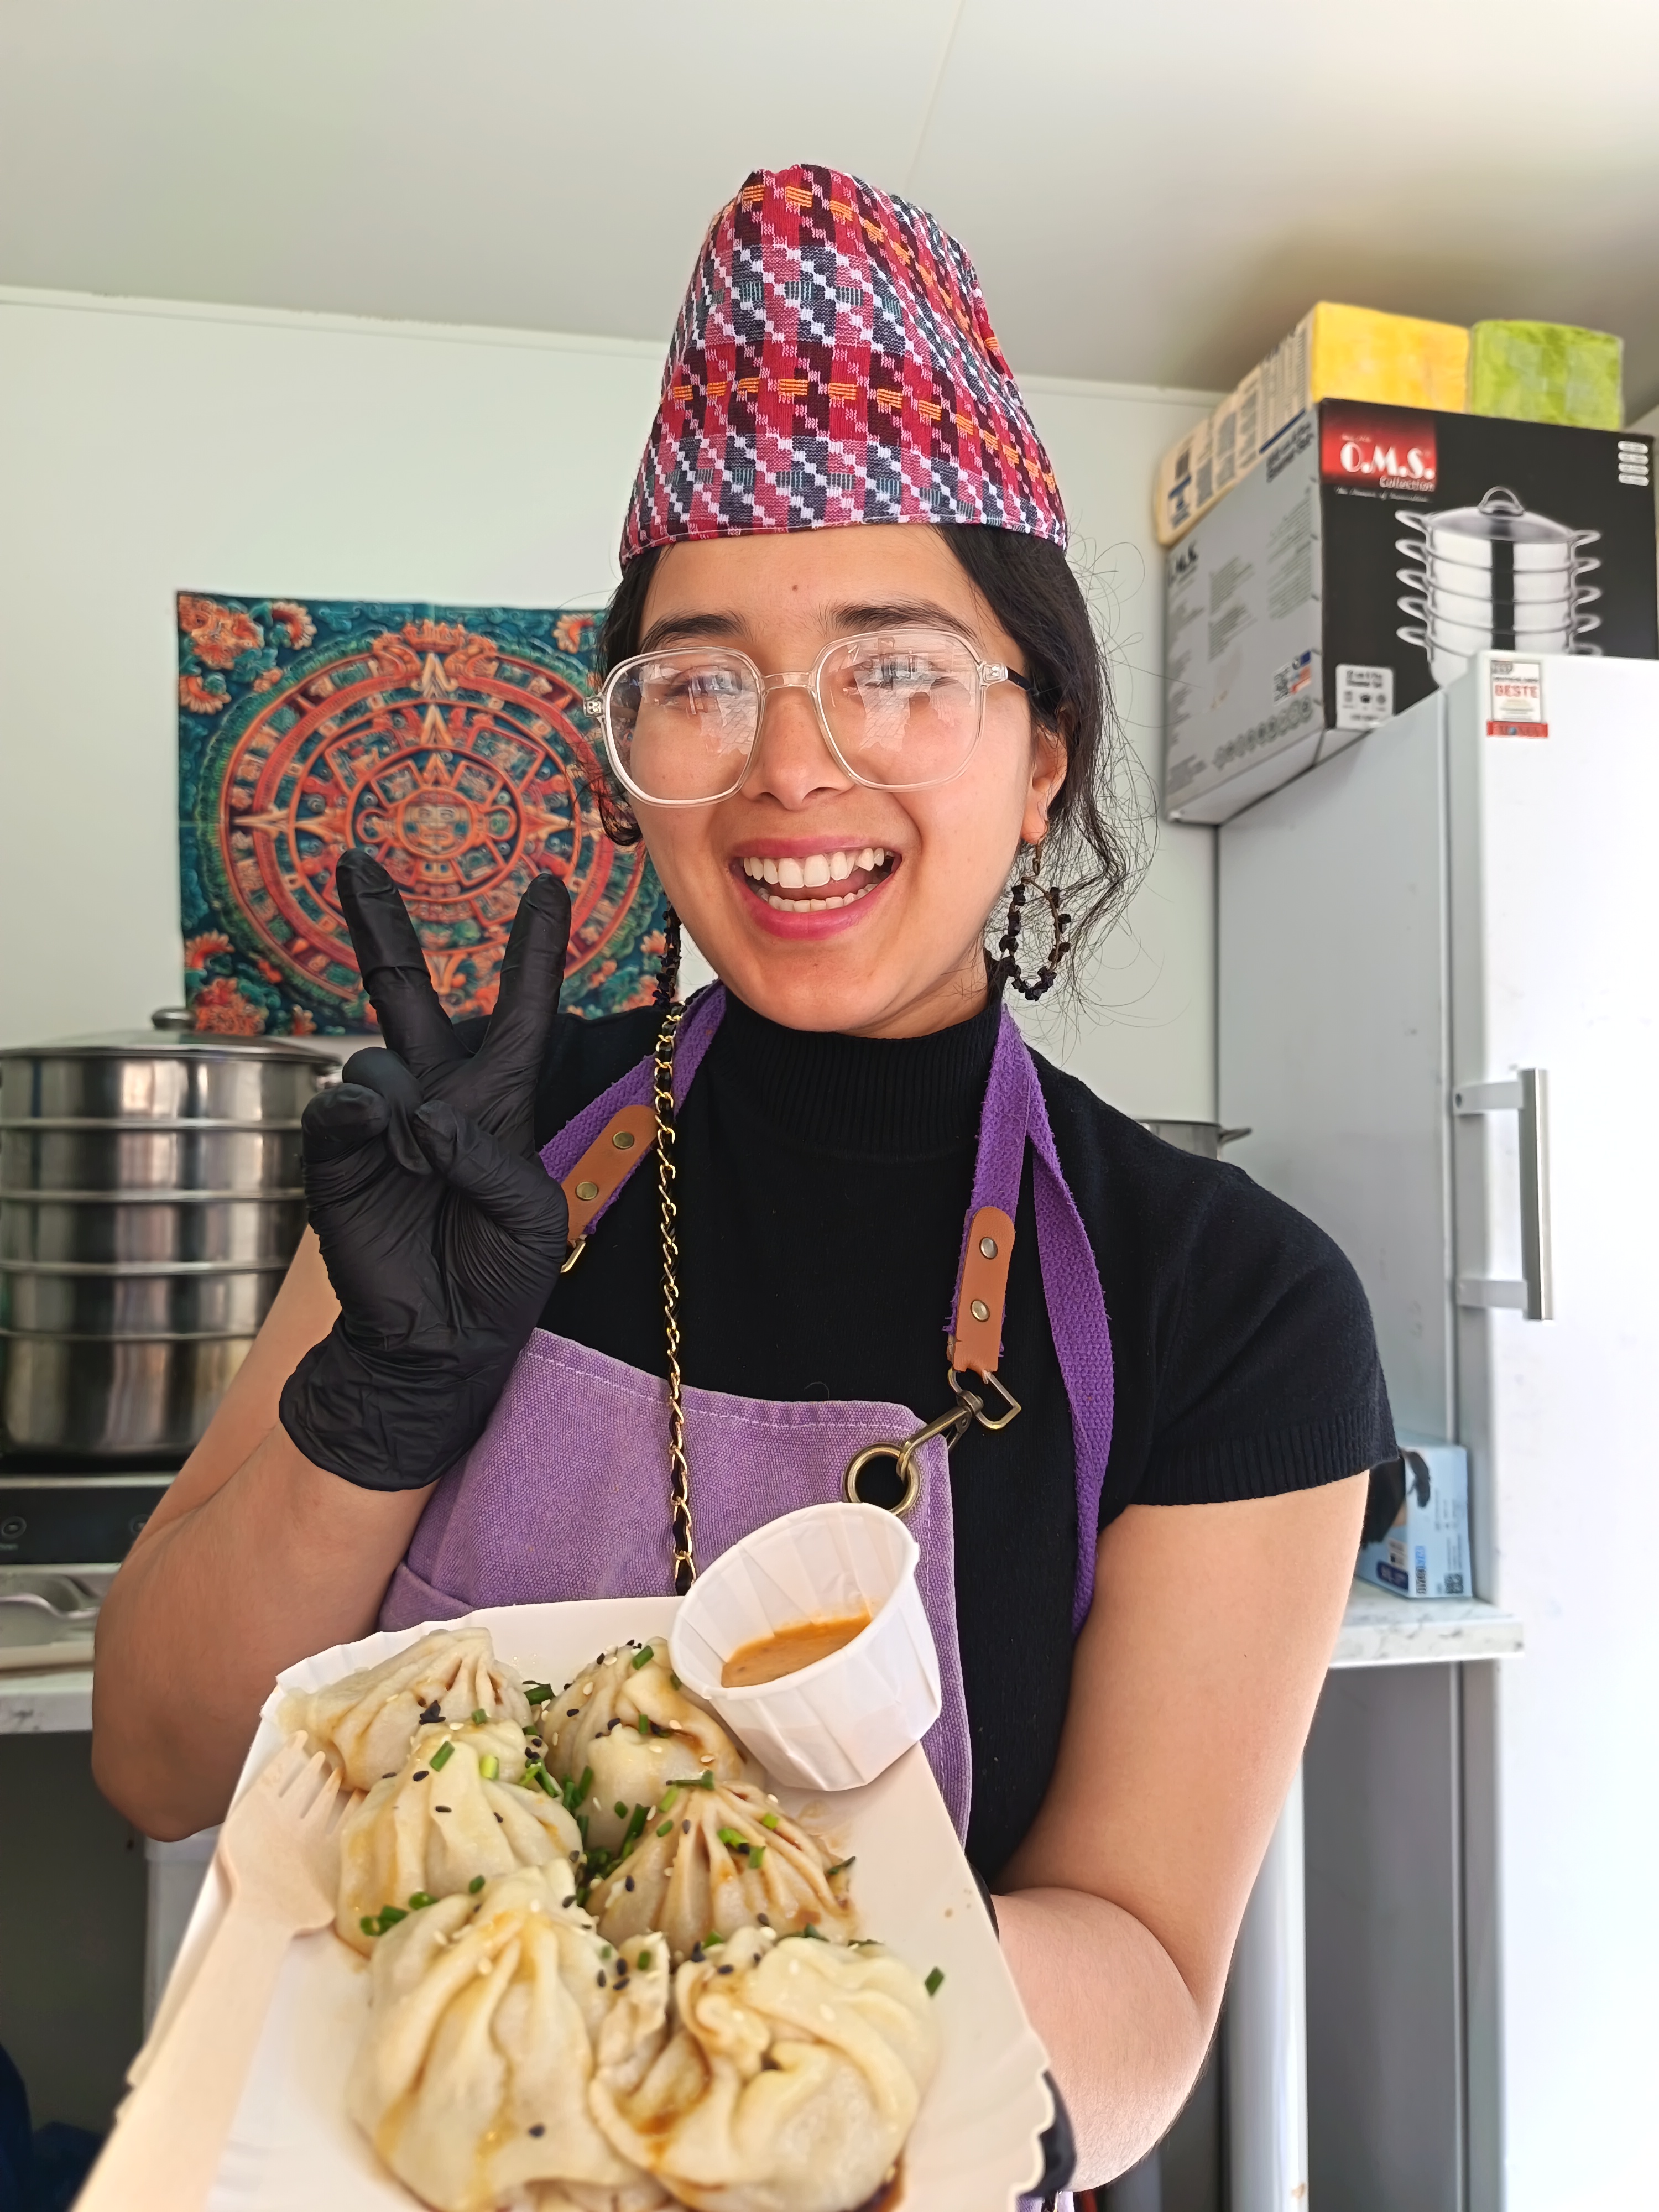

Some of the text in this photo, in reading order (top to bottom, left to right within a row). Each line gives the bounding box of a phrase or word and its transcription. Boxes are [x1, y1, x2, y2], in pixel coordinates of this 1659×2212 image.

[1340, 442, 1436, 480] O.M.S.
[1379, 476, 1436, 492] Collection
[1494, 685, 1538, 698] BESTE
